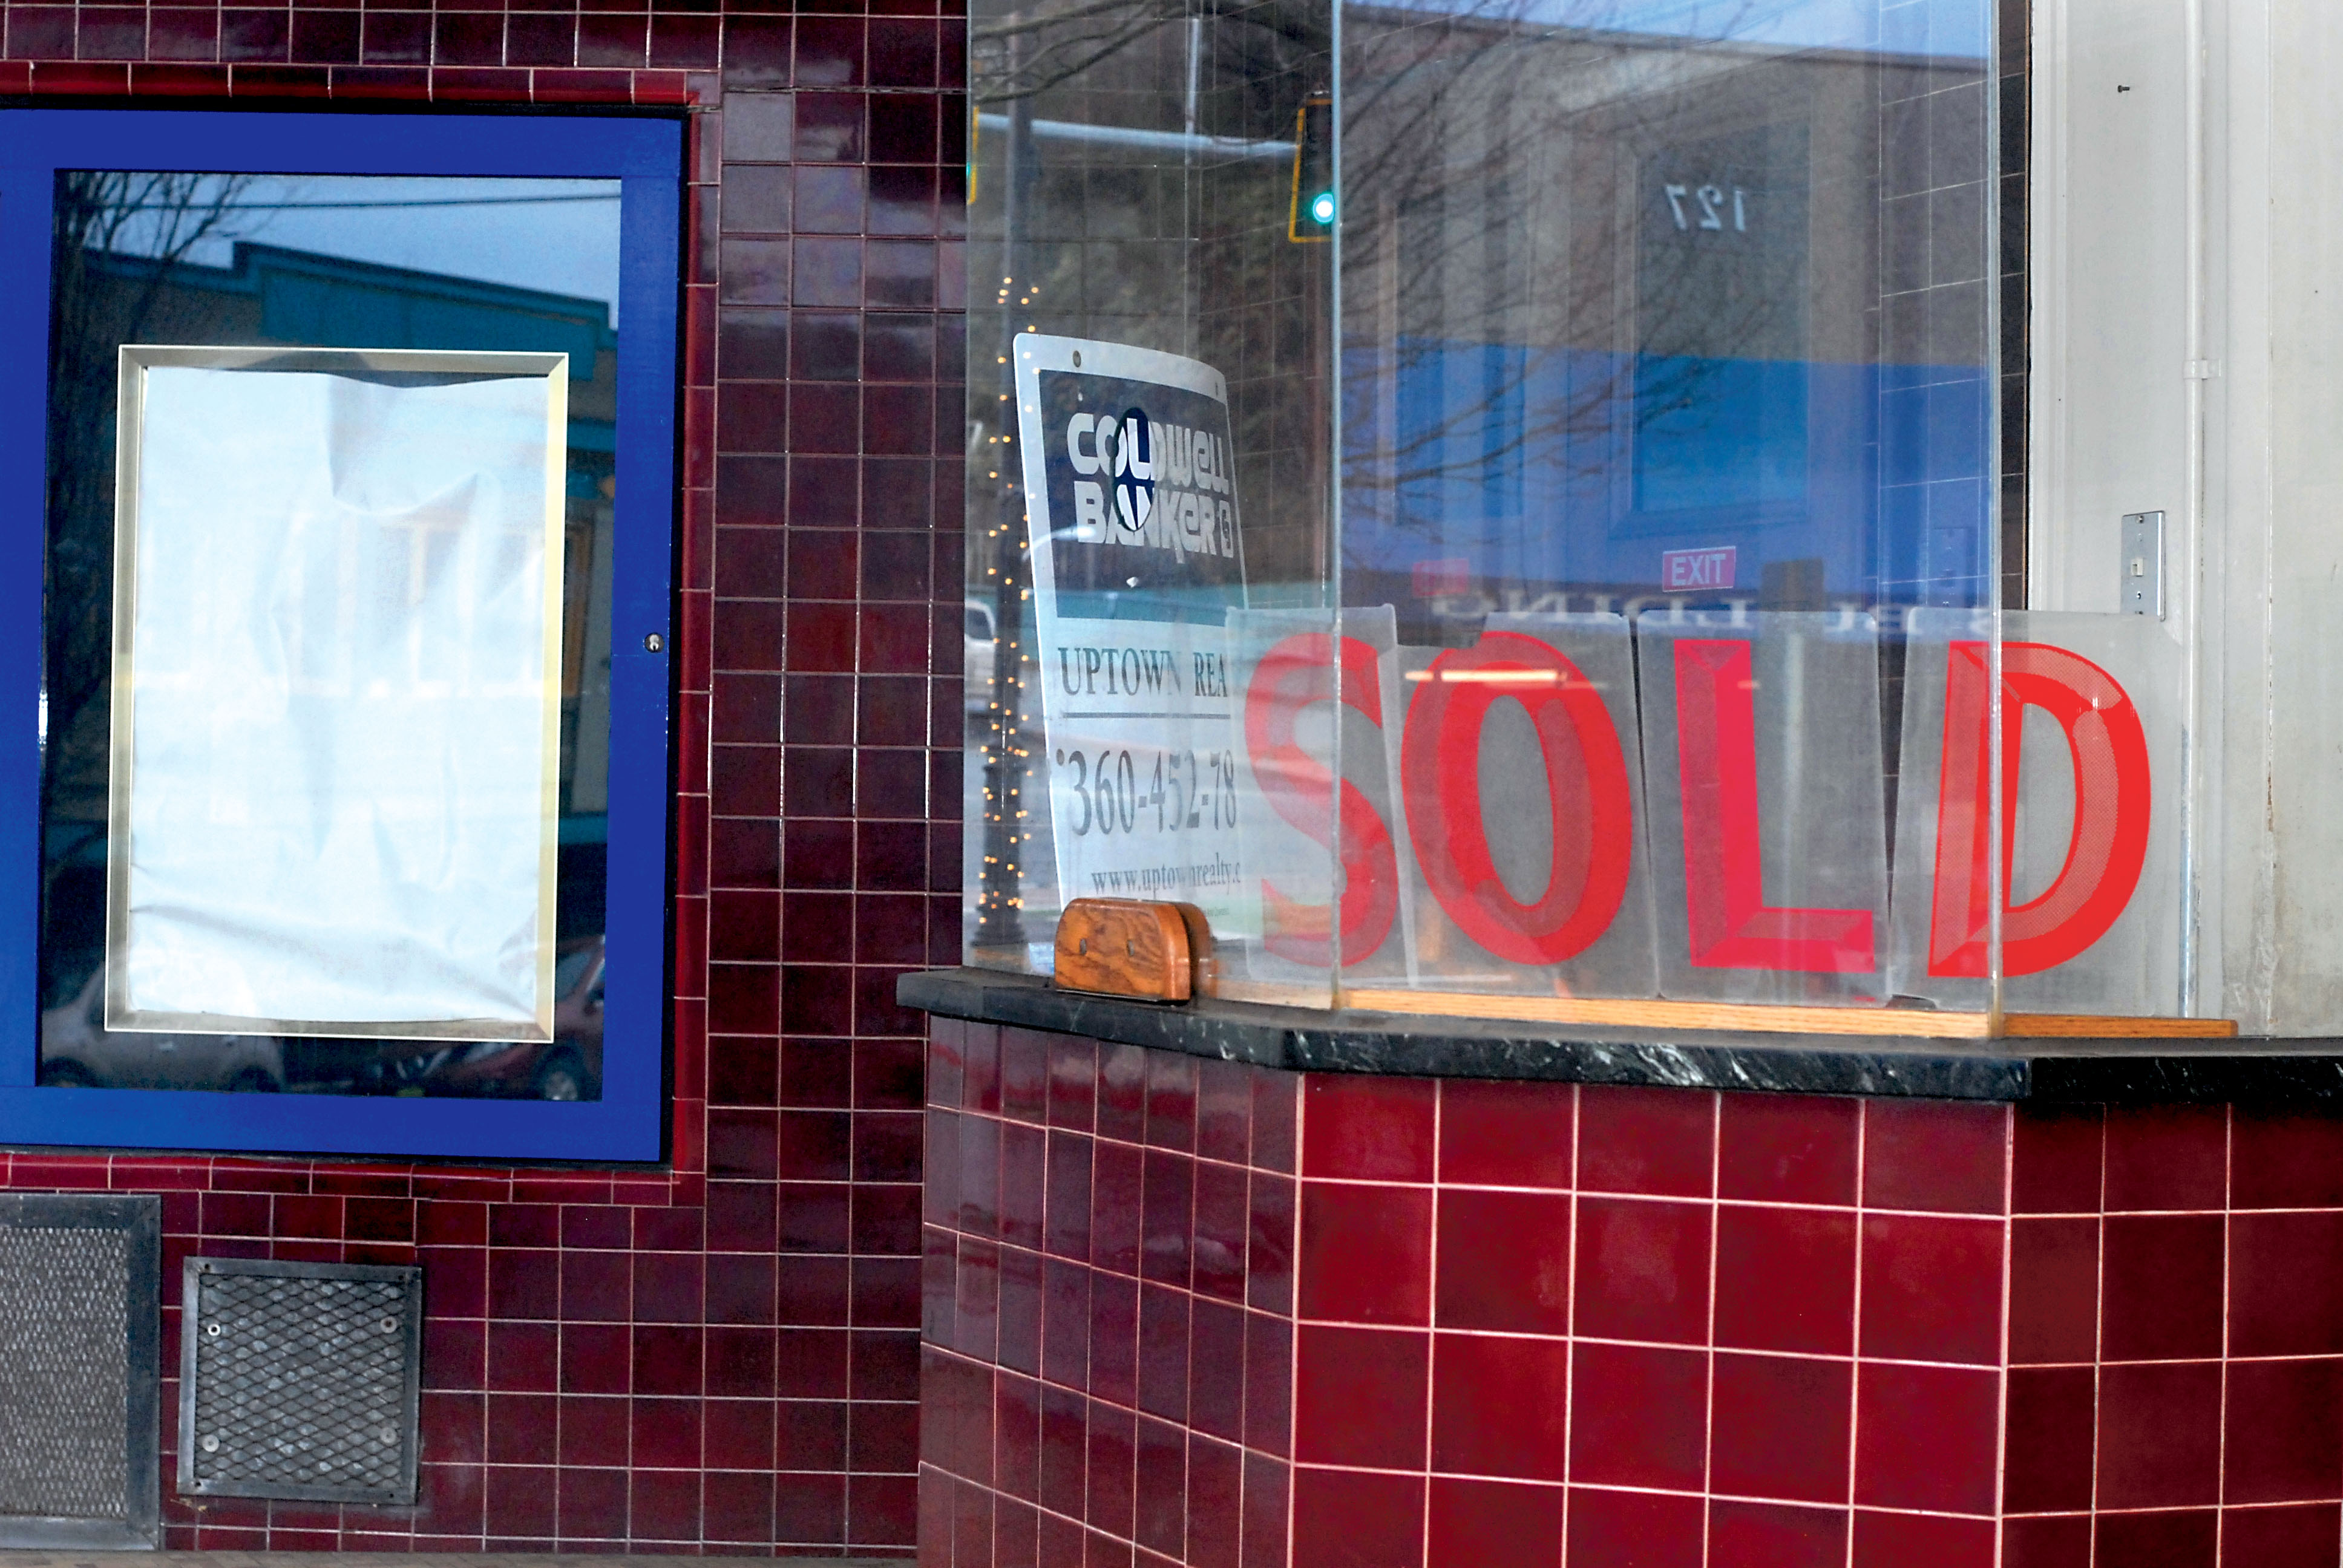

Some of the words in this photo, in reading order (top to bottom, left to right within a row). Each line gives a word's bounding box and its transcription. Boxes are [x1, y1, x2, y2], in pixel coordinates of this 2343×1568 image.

[1672, 553, 1726, 586] EXIT
[1058, 647, 1182, 696] UPTOWN
[1244, 630, 2152, 978] SOLD
